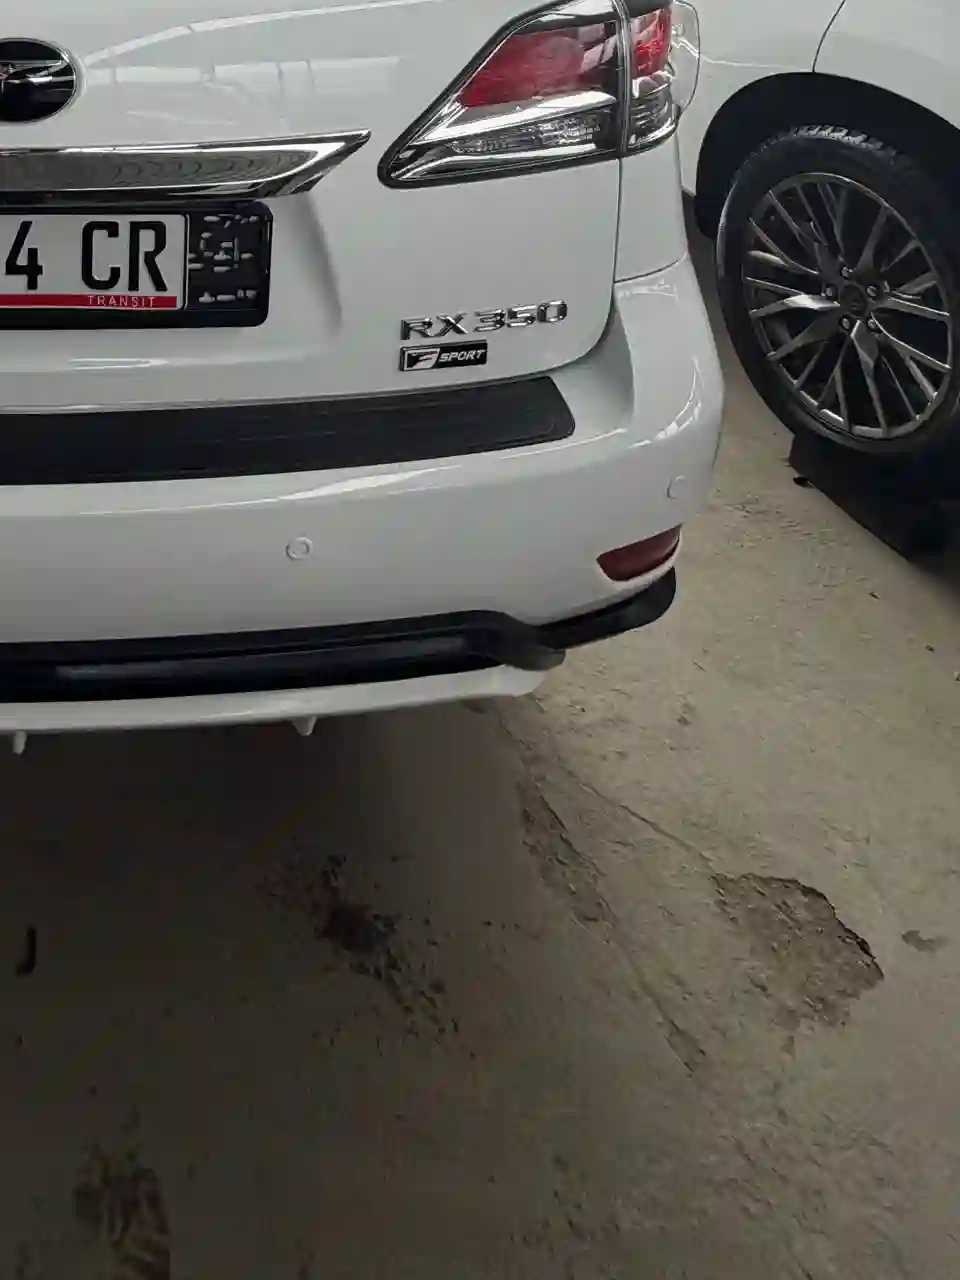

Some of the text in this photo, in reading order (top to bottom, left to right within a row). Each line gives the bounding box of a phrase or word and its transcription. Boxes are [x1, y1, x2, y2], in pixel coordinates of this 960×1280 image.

[80, 220, 167, 293] CR
[87, 295, 155, 308] TRANSIT
[401, 298, 568, 341] RX 350
[439, 349, 487, 363] SPORT
